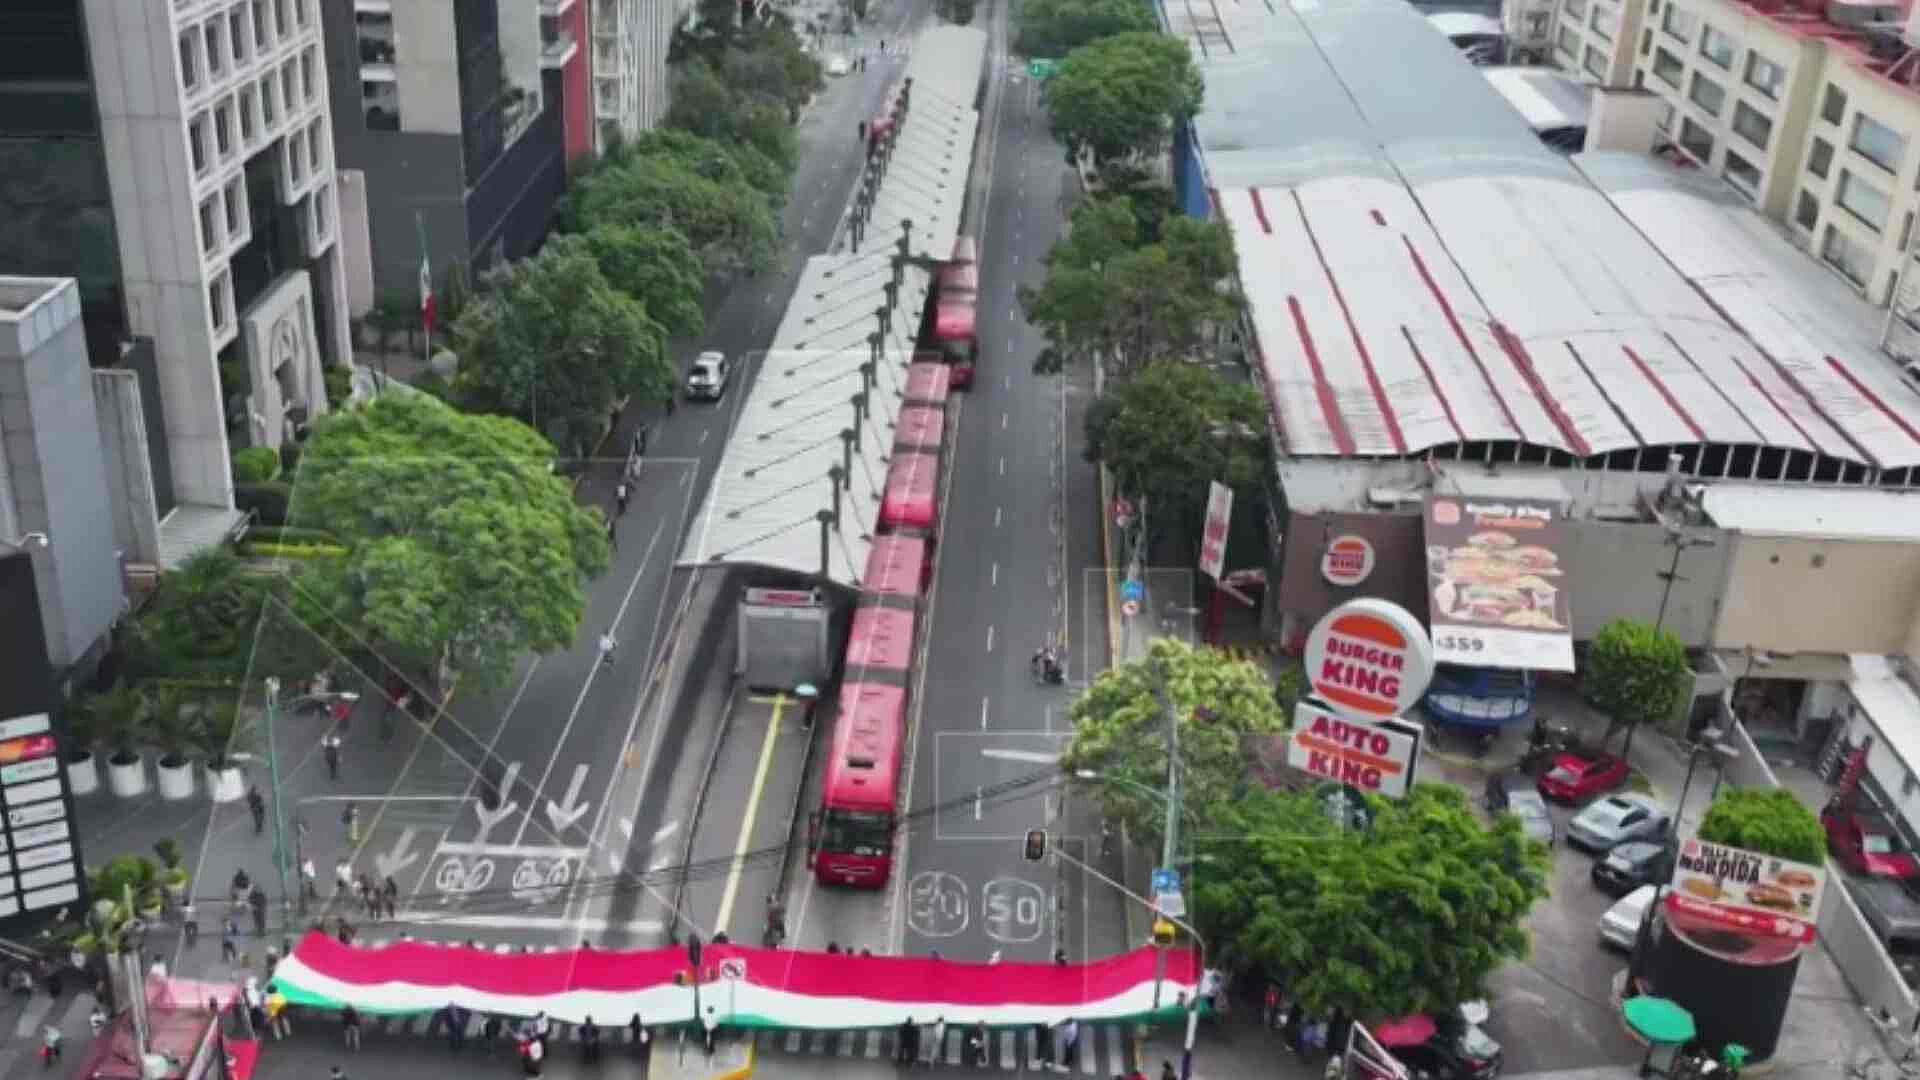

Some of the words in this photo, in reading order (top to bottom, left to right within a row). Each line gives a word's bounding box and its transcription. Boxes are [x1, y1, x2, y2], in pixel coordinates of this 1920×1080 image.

[1326, 638, 1404, 671] BURGER
[1322, 658, 1400, 698] KING
[1311, 716, 1390, 755] AUTO
[1308, 751, 1382, 789] KING
[1680, 853, 1760, 884] MORDIDA
